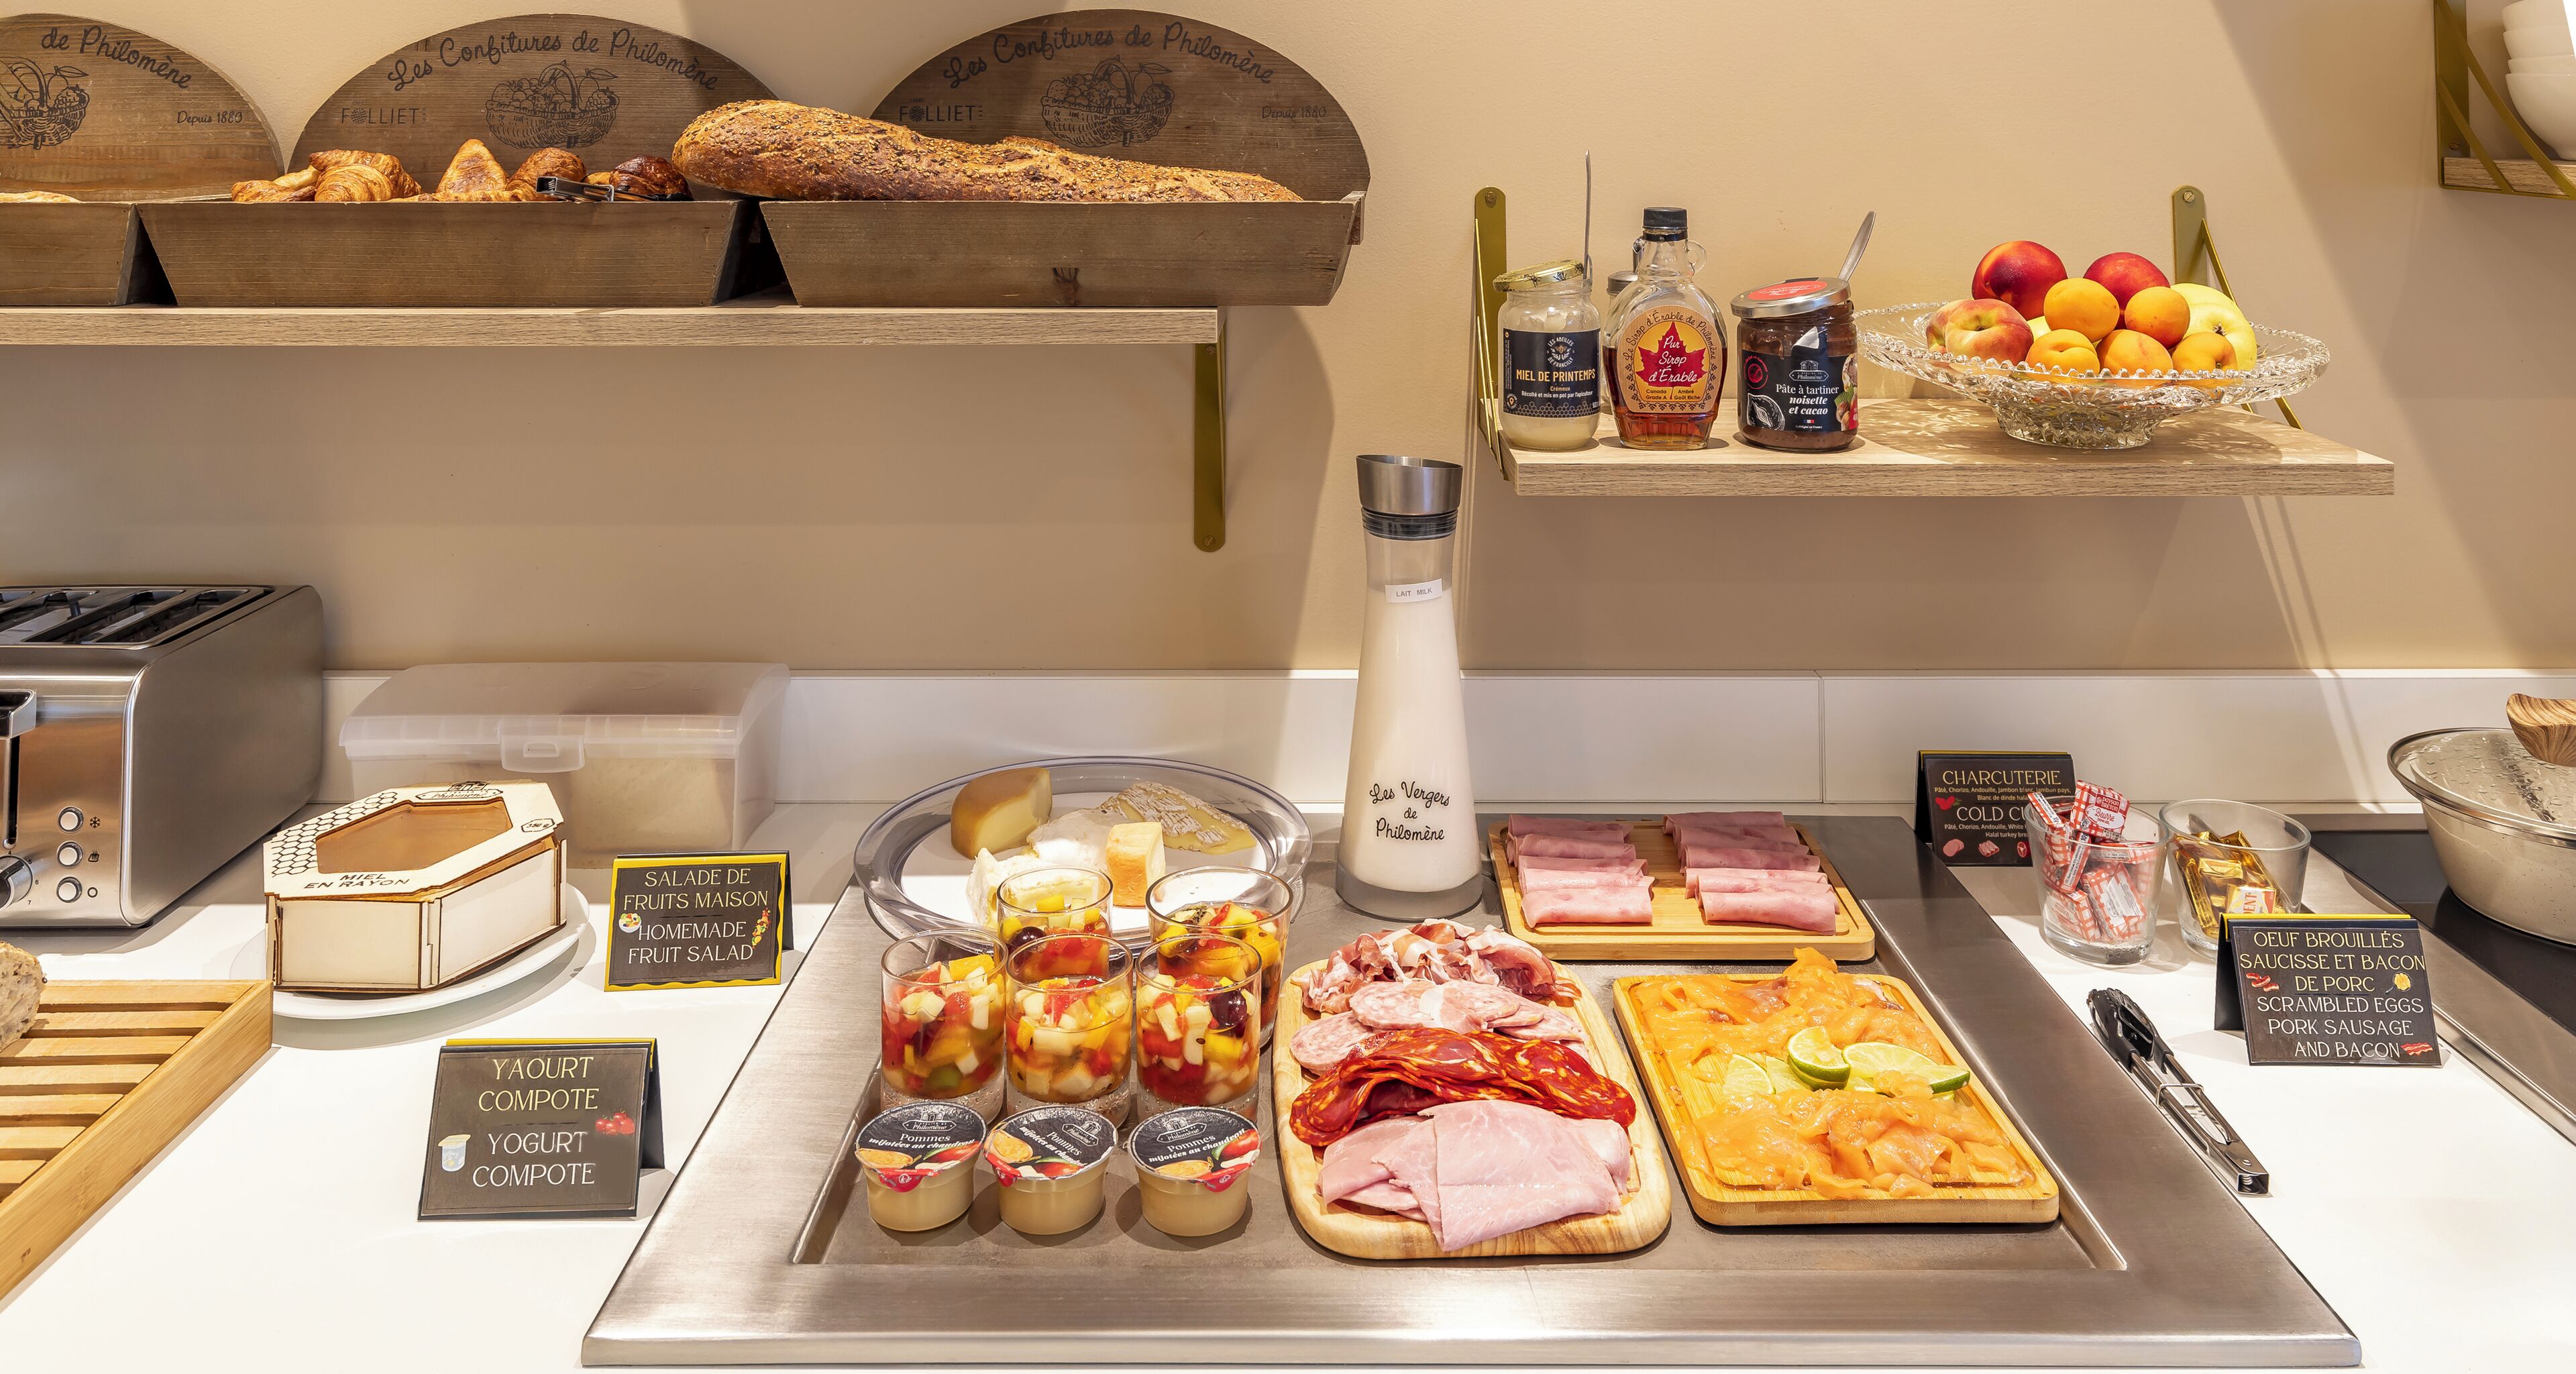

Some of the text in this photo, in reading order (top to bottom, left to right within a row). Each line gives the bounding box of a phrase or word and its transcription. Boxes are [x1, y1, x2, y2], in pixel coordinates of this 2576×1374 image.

[42, 25, 192, 89] de Philomène
[387, 28, 718, 91] Les Confitures de Philomène
[943, 21, 1274, 89] Les Confitures de Philomène
[177, 111, 243, 126] Depuis 1880
[1261, 105, 1327, 121] Depuis 1880
[1547, 336, 1574, 347] LES ABEILLES
[1623, 309, 1718, 361] Le Sirop d'Érable de Philomène
[1663, 335, 1680, 349] Pur
[1547, 356, 1555, 364] DE
[1658, 351, 1687, 367] Sirop
[1516, 368, 1596, 382] MIEL DE PRINTEMPS
[1648, 365, 1698, 382] d'Érable
[1776, 383, 1839, 394] Pâte à tartiner
[1789, 395, 1828, 405] noisette
[1788, 405, 1829, 415] et cacao
[1416, 587, 1433, 596] MILK
[1942, 770, 2061, 786] CHARCUTERIE
[1369, 781, 1450, 808] Les Vergers
[1403, 807, 1418, 819] de
[1956, 806, 2004, 821] COLD
[2094, 808, 2115, 822] Beurre
[1376, 817, 1445, 841] Philomène
[303, 879, 411, 890] EN RAYON
[339, 874, 386, 882] MIEL
[644, 868, 751, 888] SALADE DE
[623, 890, 769, 910] FRUITS MAISON
[638, 921, 747, 941] HOMEMADE
[2253, 931, 2405, 949] OEUF BROUILLÉS
[628, 944, 754, 965] FRUIT SALAD
[2239, 953, 2426, 971] SAUCISSE ET BACON
[2294, 975, 2375, 992] DE PORC
[2257, 996, 2425, 1014] SCRAMBLED EGGS
[2268, 1018, 2414, 1036] PORK SAUSAGE
[2294, 1042, 2401, 1059] AND BACON
[492, 1056, 594, 1081] YAOURT
[478, 1088, 600, 1112] COMPOTE
[487, 1131, 588, 1155] YOGURT
[900, 1133, 952, 1143] Pommes
[1019, 1126, 1048, 1149] mijotées
[1045, 1143, 1058, 1152] au
[1166, 1128, 1199, 1141] Philomène
[869, 1138, 911, 1149] mijotées
[926, 1139, 975, 1149] chaudron
[1046, 1131, 1083, 1157] Pommes
[1148, 1151, 1187, 1163] mijotées
[1188, 1147, 1201, 1155] au
[1202, 1128, 1246, 1151] chaudron
[1166, 1134, 1216, 1153] Pommes
[472, 1163, 596, 1187] COMPOTE
